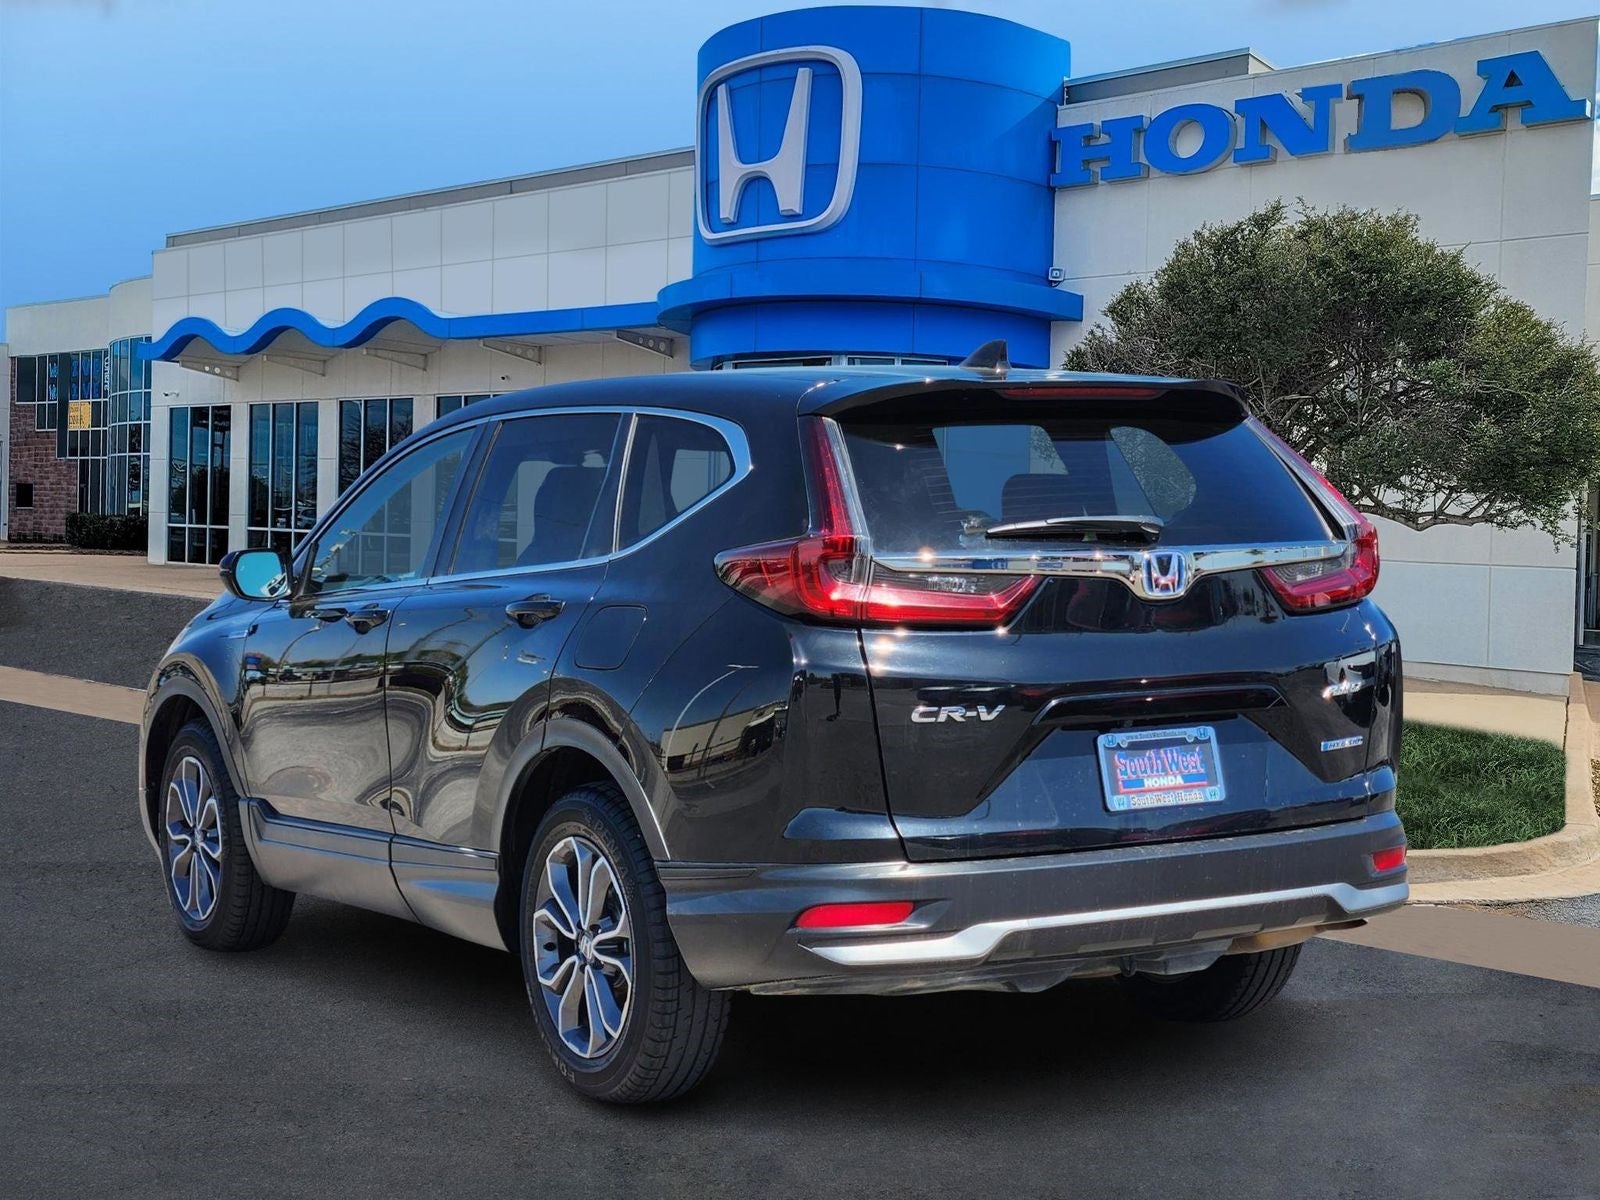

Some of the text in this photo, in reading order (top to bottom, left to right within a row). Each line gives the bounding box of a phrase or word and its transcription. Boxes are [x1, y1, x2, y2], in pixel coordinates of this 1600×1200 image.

[1051, 50, 1591, 188] HONDA
[911, 704, 1006, 723] CR-V
[1143, 774, 1185, 788] HONDA
